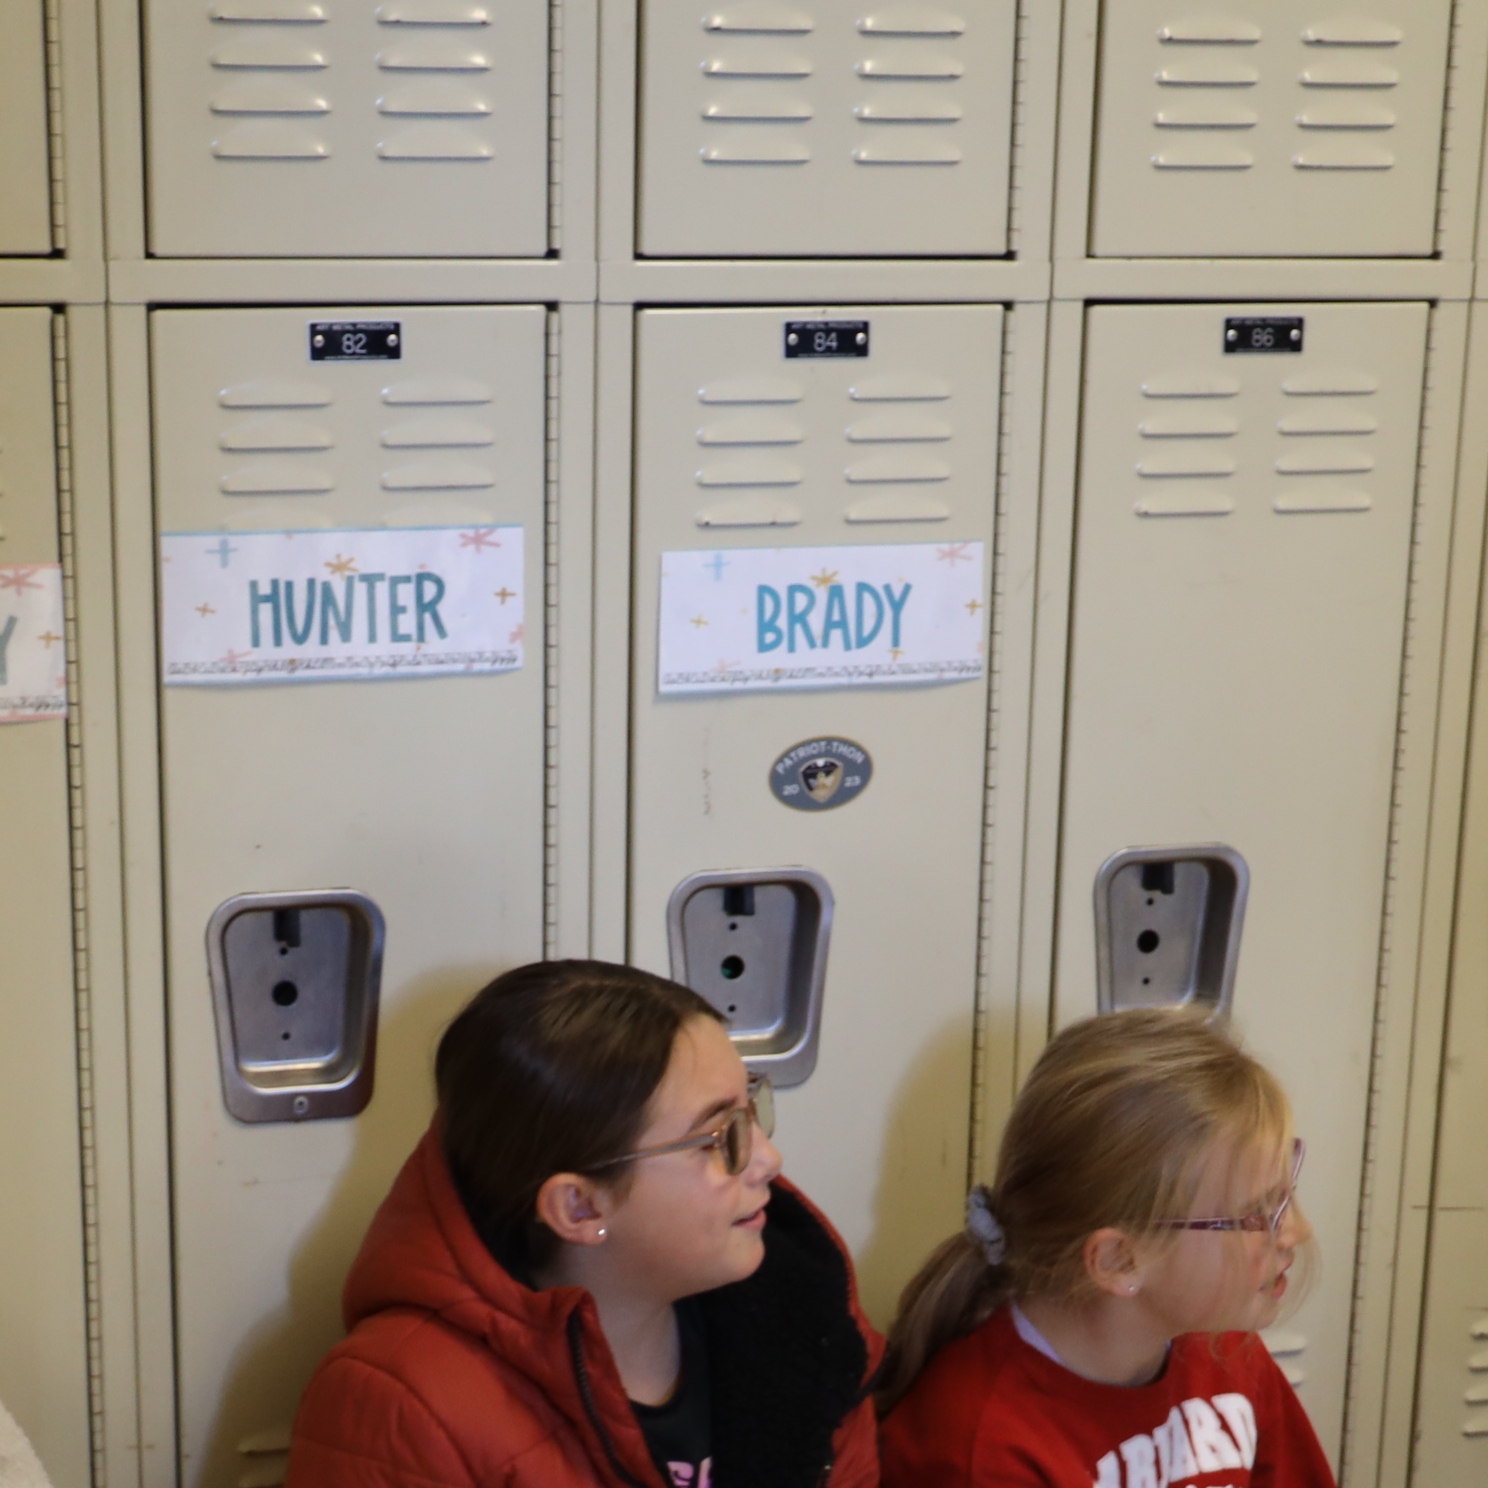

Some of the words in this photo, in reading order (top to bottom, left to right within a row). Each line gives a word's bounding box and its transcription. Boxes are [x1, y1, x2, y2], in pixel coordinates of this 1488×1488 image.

[341, 333, 367, 354] 82
[813, 331, 839, 352] 84
[1251, 327, 1275, 348] 86
[249, 571, 449, 648] HUNTER
[757, 581, 913, 653] BRADY
[775, 740, 866, 775] PATRIOT-THON
[782, 783, 800, 797] 20
